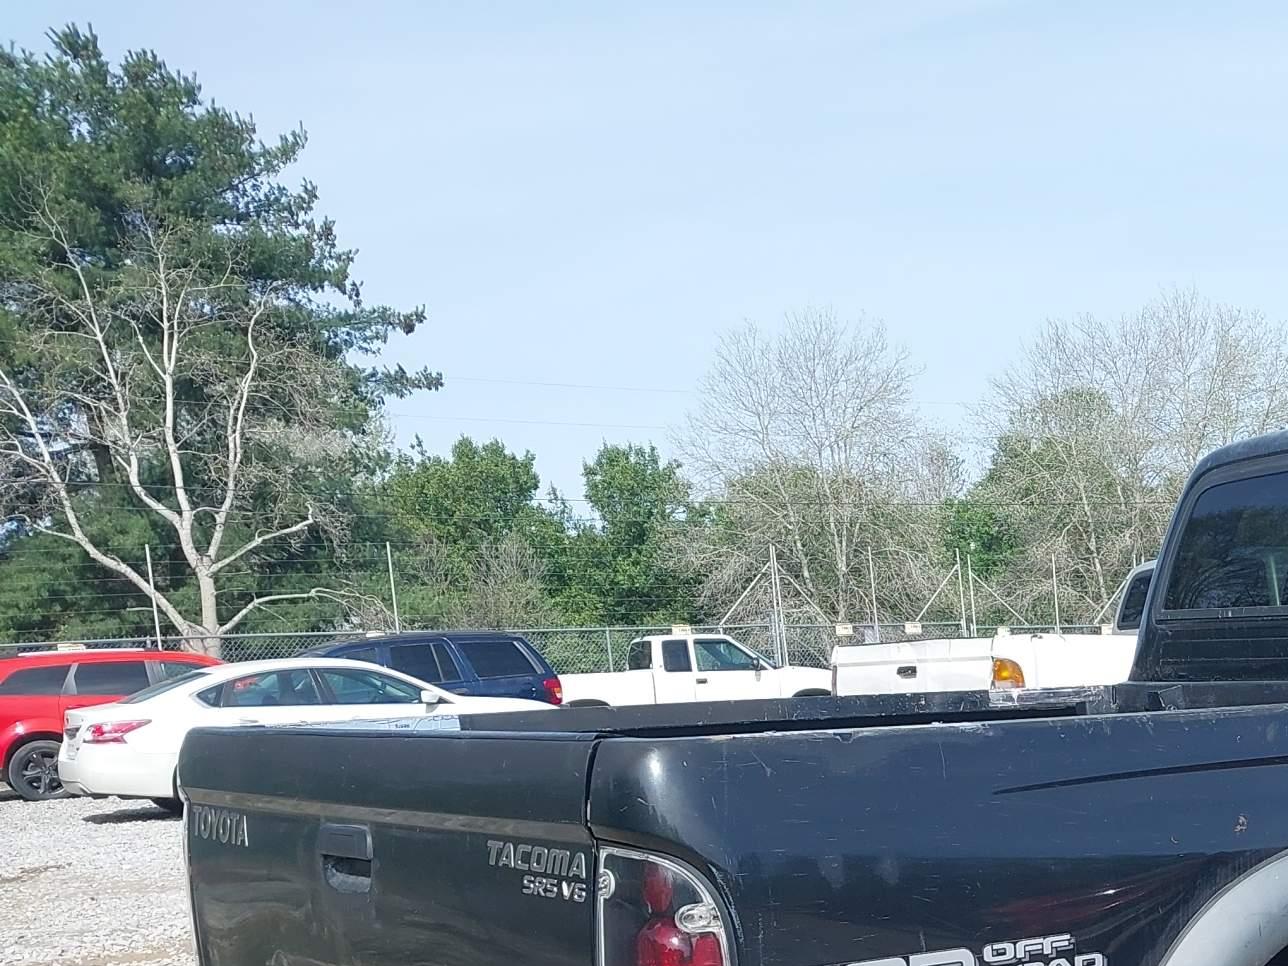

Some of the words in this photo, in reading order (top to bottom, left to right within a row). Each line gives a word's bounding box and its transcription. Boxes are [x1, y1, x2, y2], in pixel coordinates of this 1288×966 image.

[192, 805, 249, 848] TOYOTA
[487, 840, 586, 879] TACOMA
[522, 875, 558, 898] SR5
[561, 881, 587, 902] V6
[983, 933, 1075, 966] OFF
